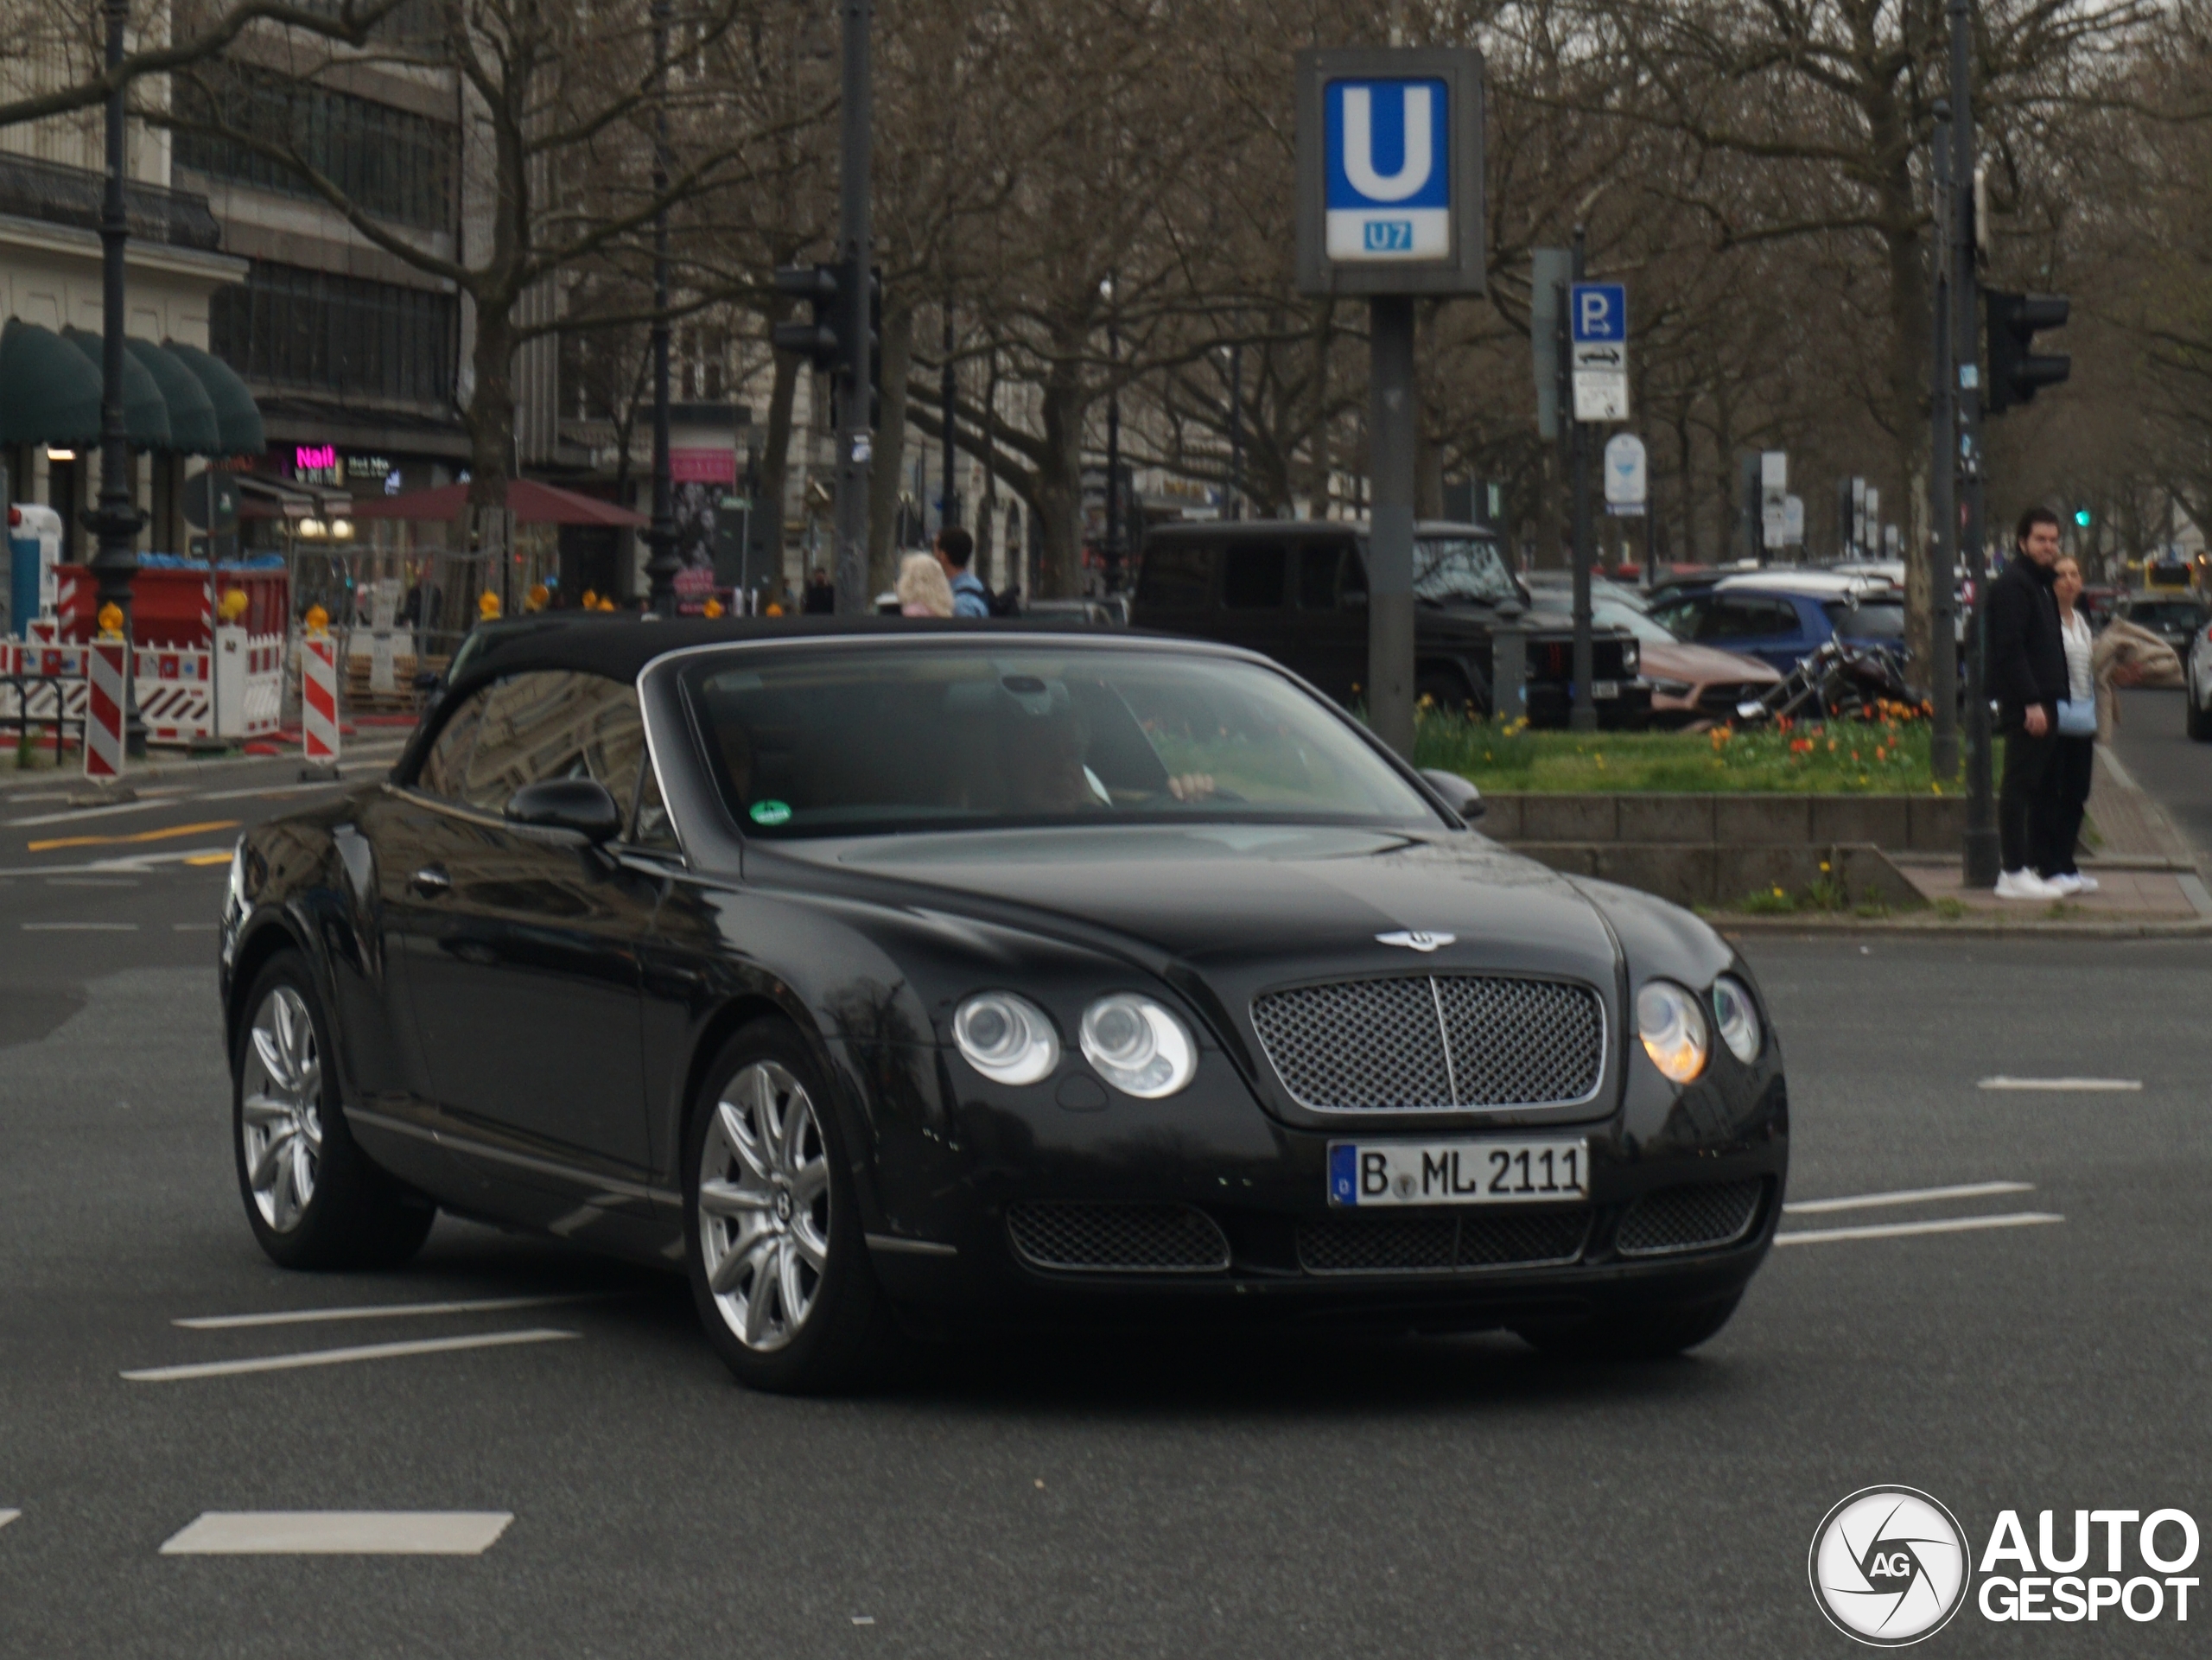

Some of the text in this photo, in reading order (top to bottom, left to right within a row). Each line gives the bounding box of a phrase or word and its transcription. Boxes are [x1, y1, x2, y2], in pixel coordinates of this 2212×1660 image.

[1343, 86, 1432, 202] U
[1369, 223, 1407, 248] U7
[1580, 291, 1609, 335] P
[296, 444, 336, 469] Nail
[1362, 1148, 1582, 1196] B ML 2111
